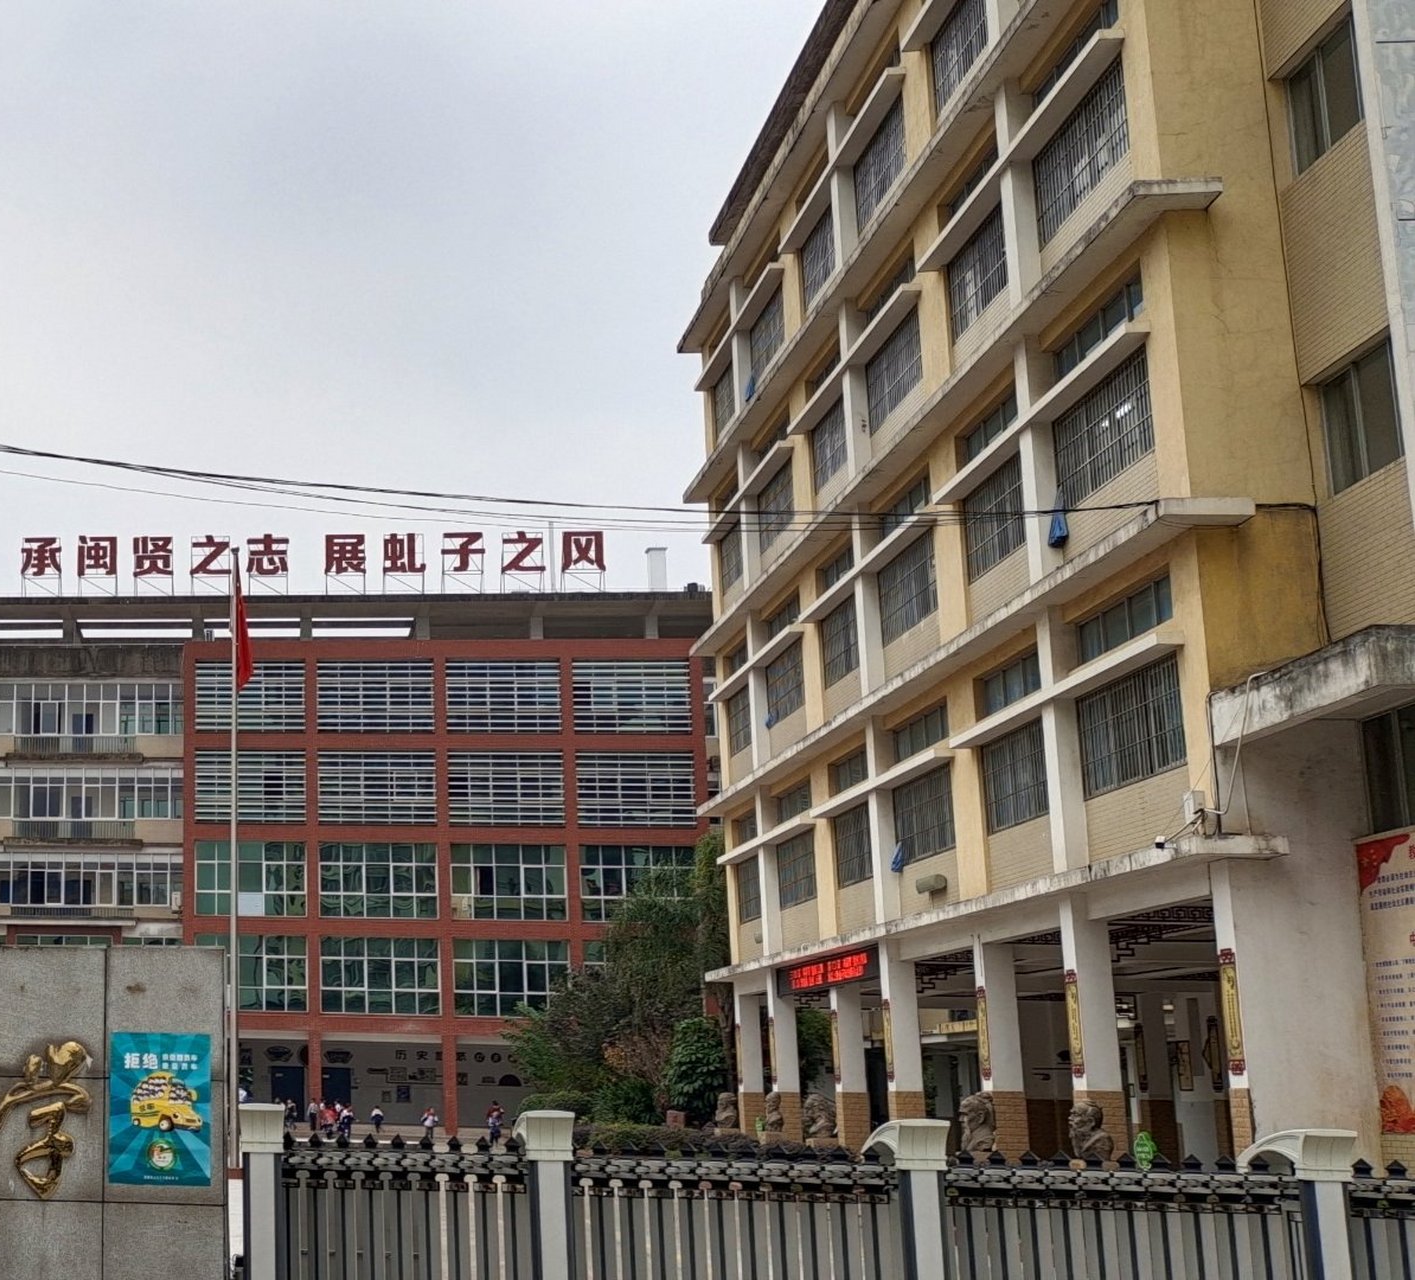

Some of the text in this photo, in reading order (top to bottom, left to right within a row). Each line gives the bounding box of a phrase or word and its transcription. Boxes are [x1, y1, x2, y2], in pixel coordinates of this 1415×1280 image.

[20, 530, 606, 577] 承闽贤之志 展虬子之风
[124, 1052, 158, 1070] 拒绝
